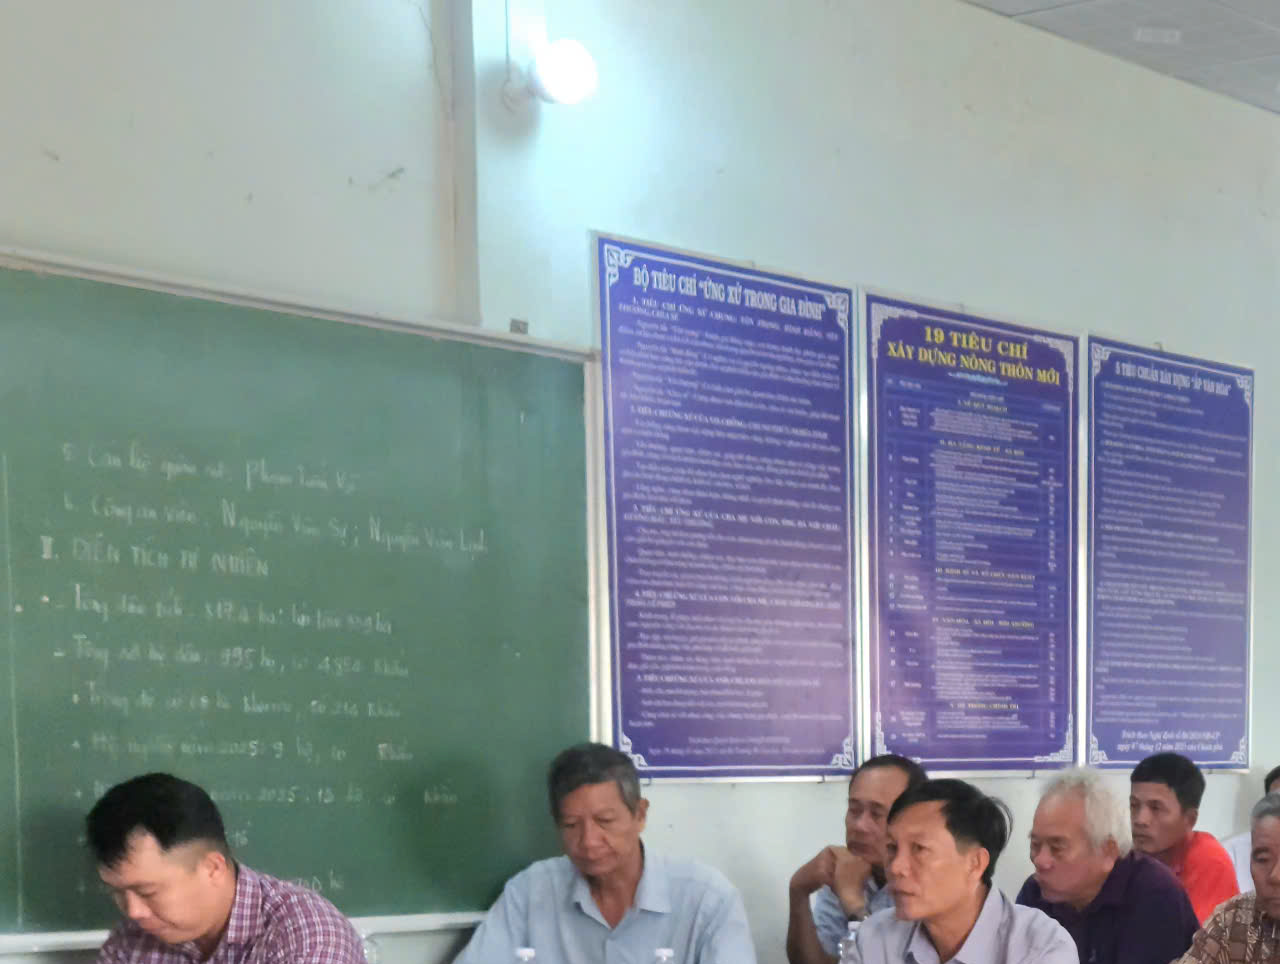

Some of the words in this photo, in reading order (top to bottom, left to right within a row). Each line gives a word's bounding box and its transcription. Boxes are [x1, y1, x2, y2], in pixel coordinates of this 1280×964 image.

[633, 264, 650, 291] BỘ
[652, 269, 676, 291] TIÊU
[678, 273, 697, 296] CHÍ
[727, 281, 742, 304] XỬ
[744, 289, 778, 312] TRONG
[780, 295, 798, 315] GIA
[887, 340, 915, 360] XÂY
[918, 346, 956, 367] DỰNG
[960, 353, 996, 374] NÔNG
[999, 361, 1033, 380] THÔN
[1036, 367, 1061, 386] MỚI
[924, 325, 945, 344] 19
[949, 331, 993, 353] TIÊU
[997, 341, 1028, 360] CHÍ
